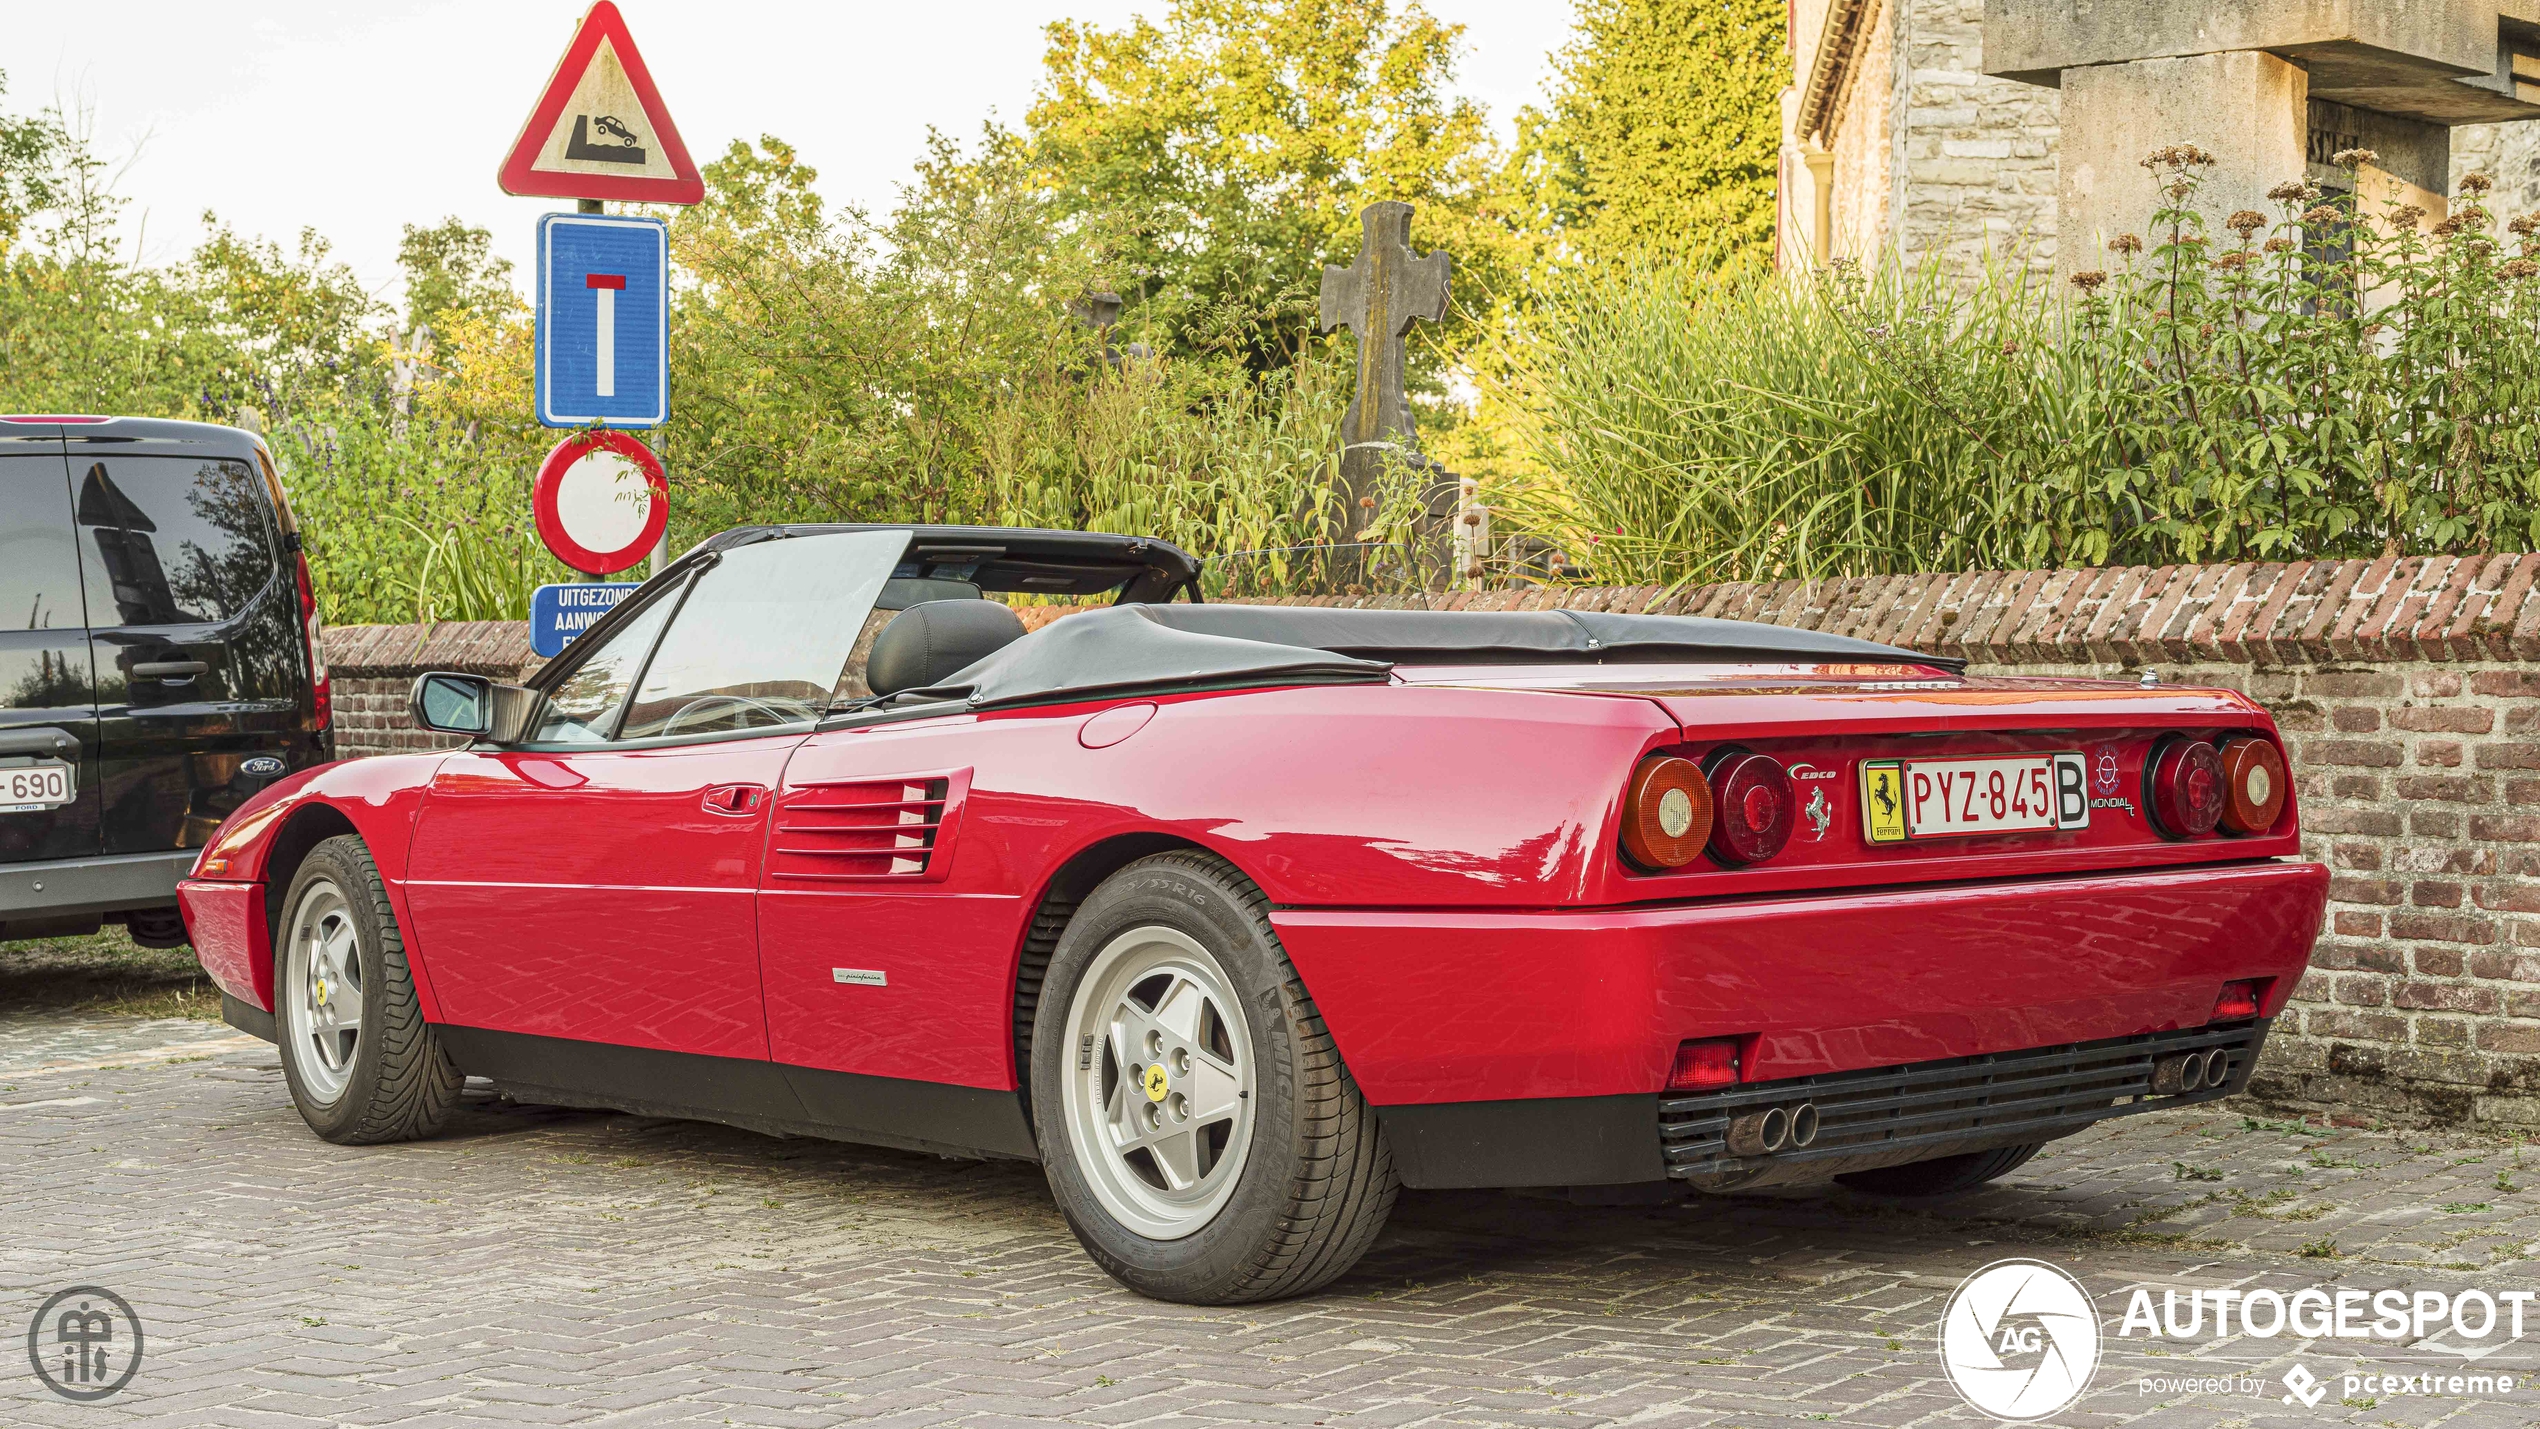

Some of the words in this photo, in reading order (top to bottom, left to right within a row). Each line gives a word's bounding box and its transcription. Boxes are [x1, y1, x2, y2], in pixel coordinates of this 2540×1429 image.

[251, 761, 276, 773] Ford
[1800, 771, 1837, 780] EDCO
[1913, 768, 2049, 824] PYZ-845
[2057, 761, 2086, 823] B
[2090, 797, 2131, 809] MONDIAL
[1876, 826, 1901, 836] Ferrari
